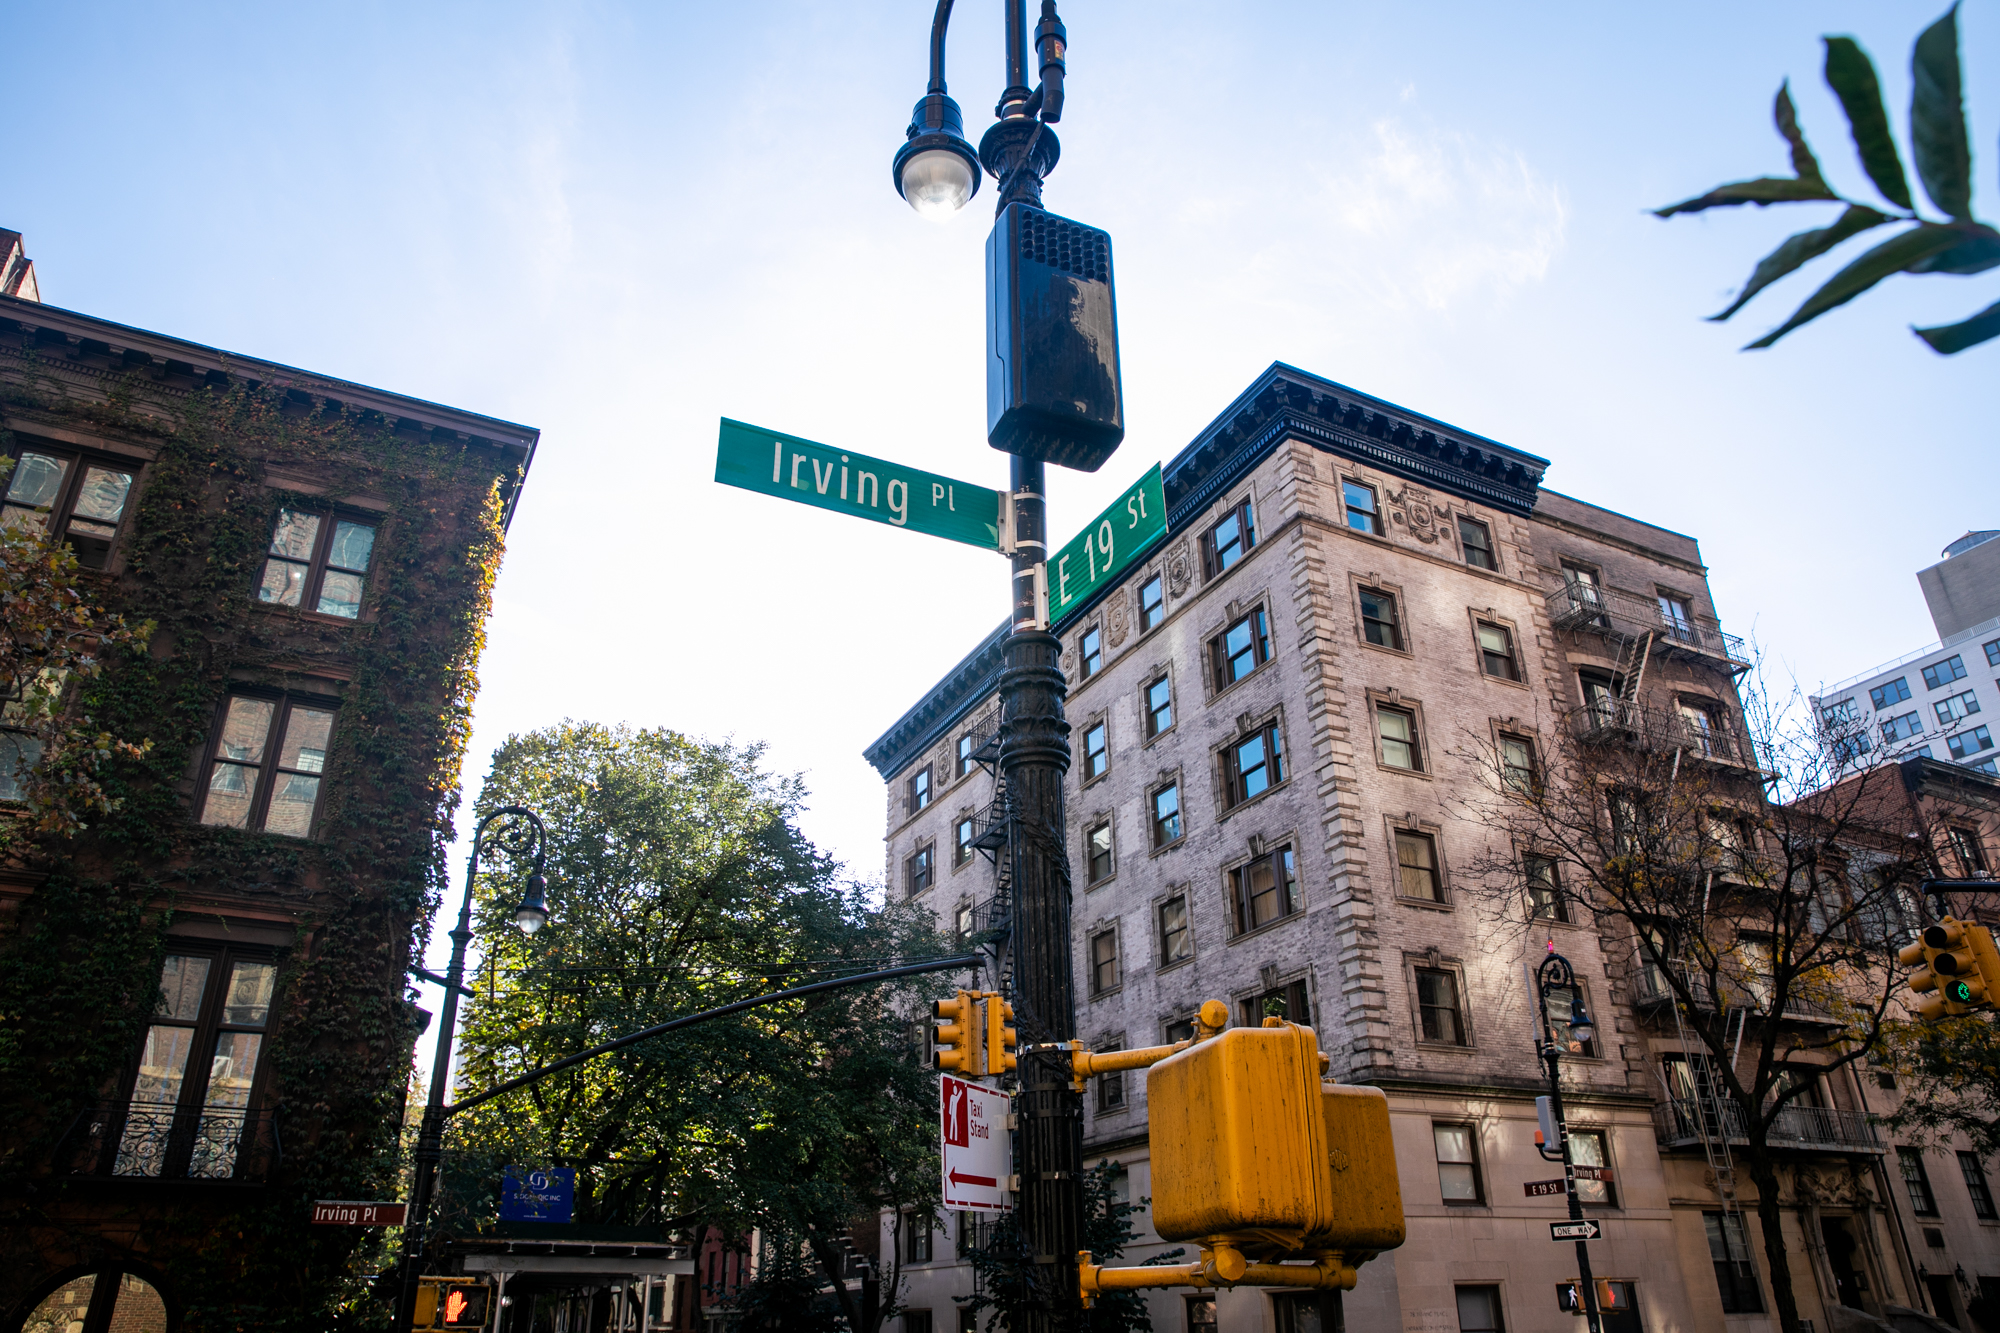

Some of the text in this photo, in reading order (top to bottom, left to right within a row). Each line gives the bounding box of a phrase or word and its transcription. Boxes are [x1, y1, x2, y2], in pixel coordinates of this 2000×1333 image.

[772, 441, 955, 526] Irving Pl
[1058, 488, 1147, 607] E 19 St
[970, 1099, 983, 1118] Taxi
[970, 1120, 989, 1139] Stand
[1573, 1168, 1602, 1180] Irving Pl
[1532, 1183, 1558, 1195] E 19 St
[315, 1206, 377, 1225] Irving Pl
[1557, 1226, 1592, 1236] ONE WAY
